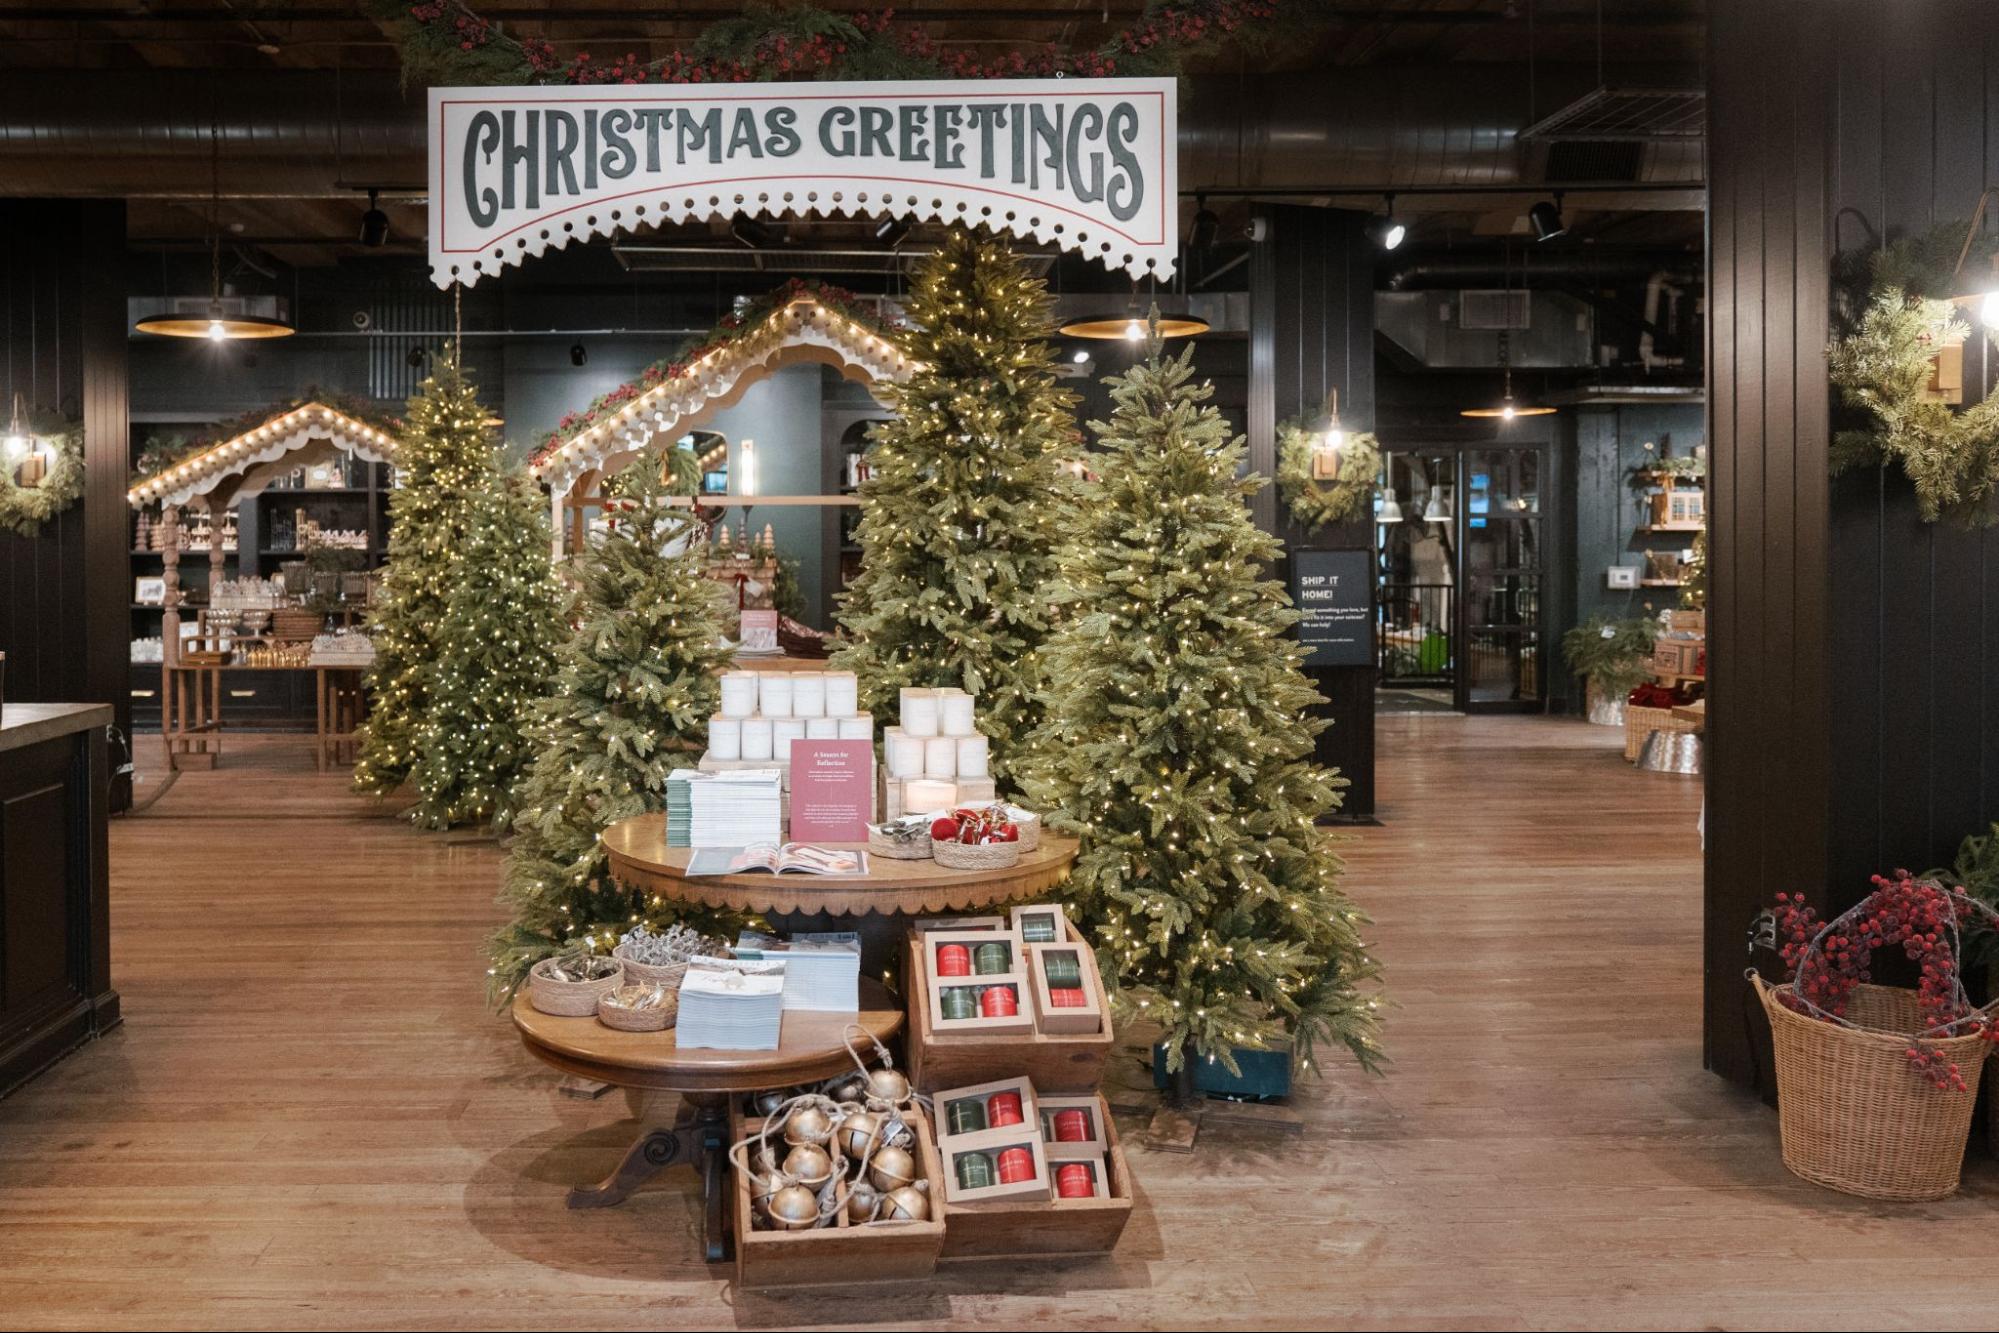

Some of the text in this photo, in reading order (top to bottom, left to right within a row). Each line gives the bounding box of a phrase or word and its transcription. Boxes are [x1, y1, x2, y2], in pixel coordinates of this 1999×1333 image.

[463, 101, 1145, 230] CHRISTMAS GREETINGS
[1301, 576, 1339, 585] SHIP IT
[1301, 590, 1333, 599] HOME!
